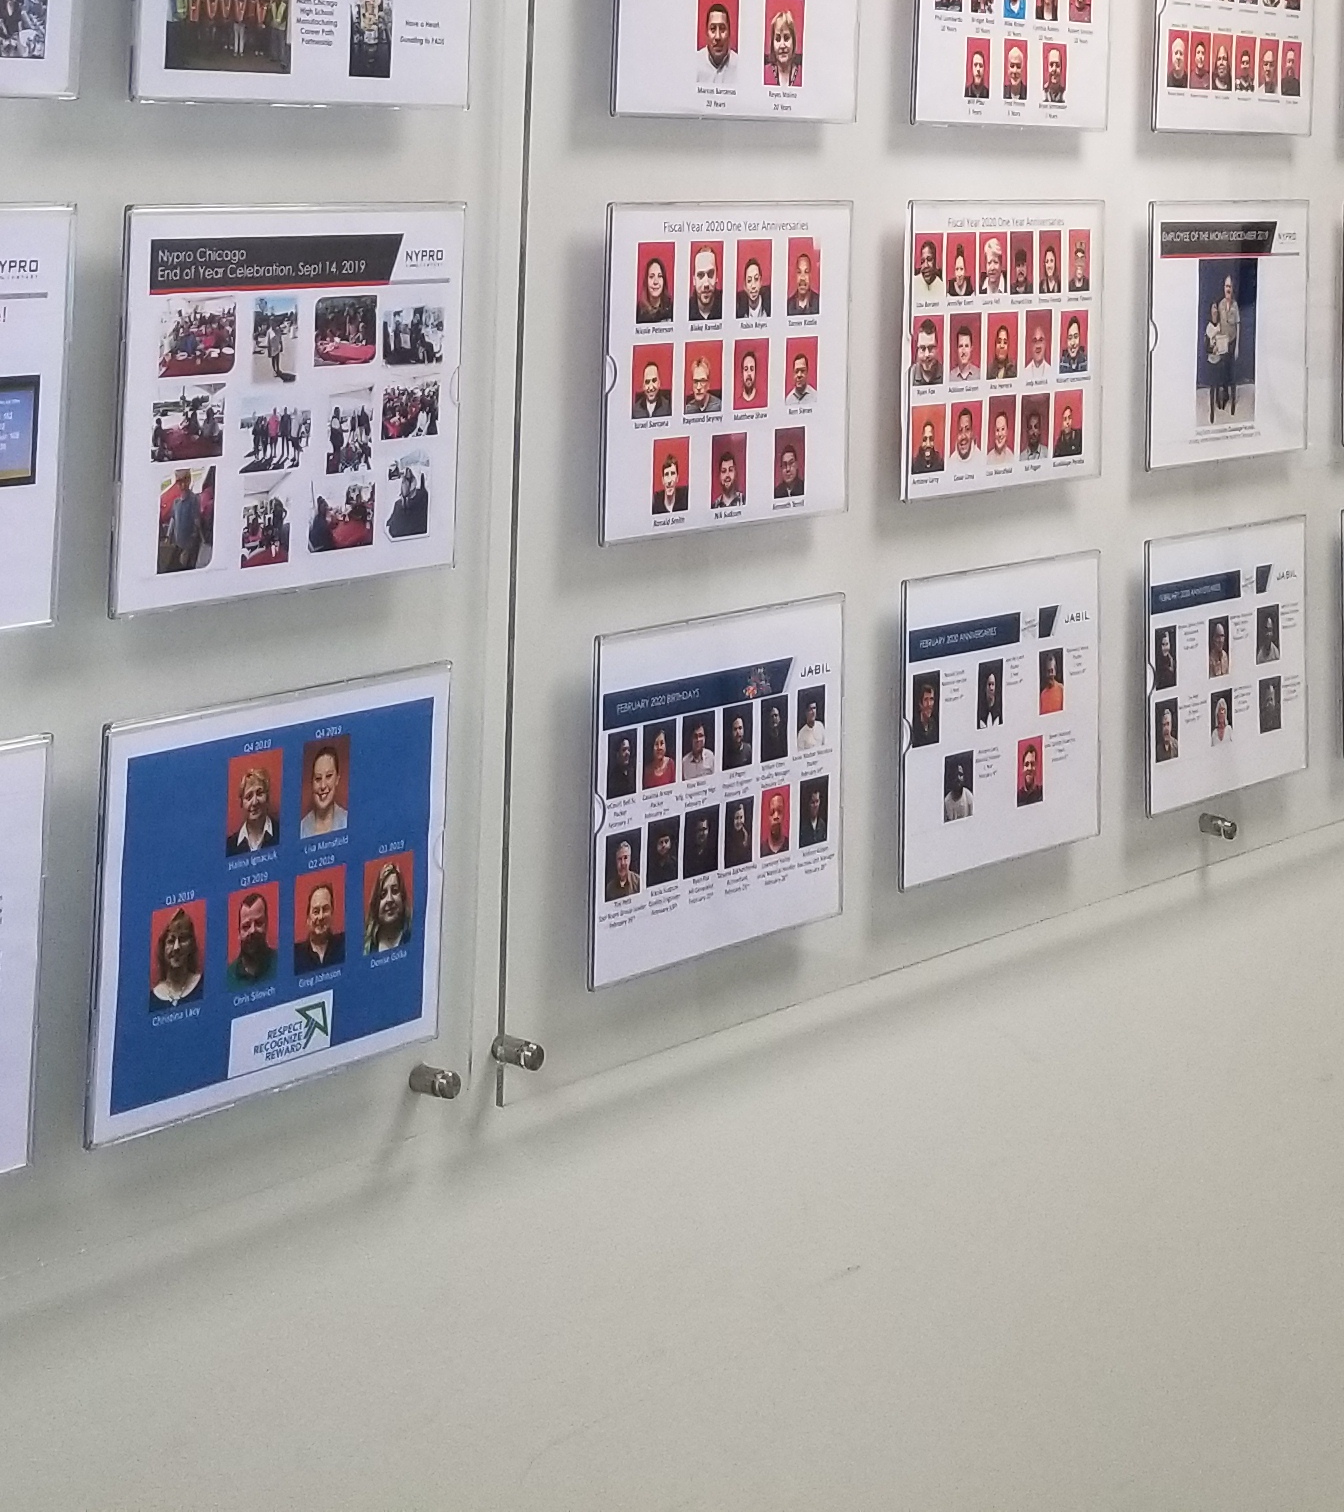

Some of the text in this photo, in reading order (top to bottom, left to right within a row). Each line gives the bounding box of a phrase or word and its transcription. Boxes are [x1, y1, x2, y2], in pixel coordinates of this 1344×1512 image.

[663, 220, 809, 233] Fiscal Year 2020 One Year Anniversaries
[158, 247, 247, 266] Nypro Chicago
[405, 250, 444, 262] NYPRO
[157, 260, 366, 281] End of Year Celebration, Sept 14, 2019
[1064, 610, 1090, 624] JABIL
[800, 663, 831, 678] JABIL
[265, 1020, 304, 1040] RESPECT
[252, 1031, 304, 1055] RECOGNIZE
